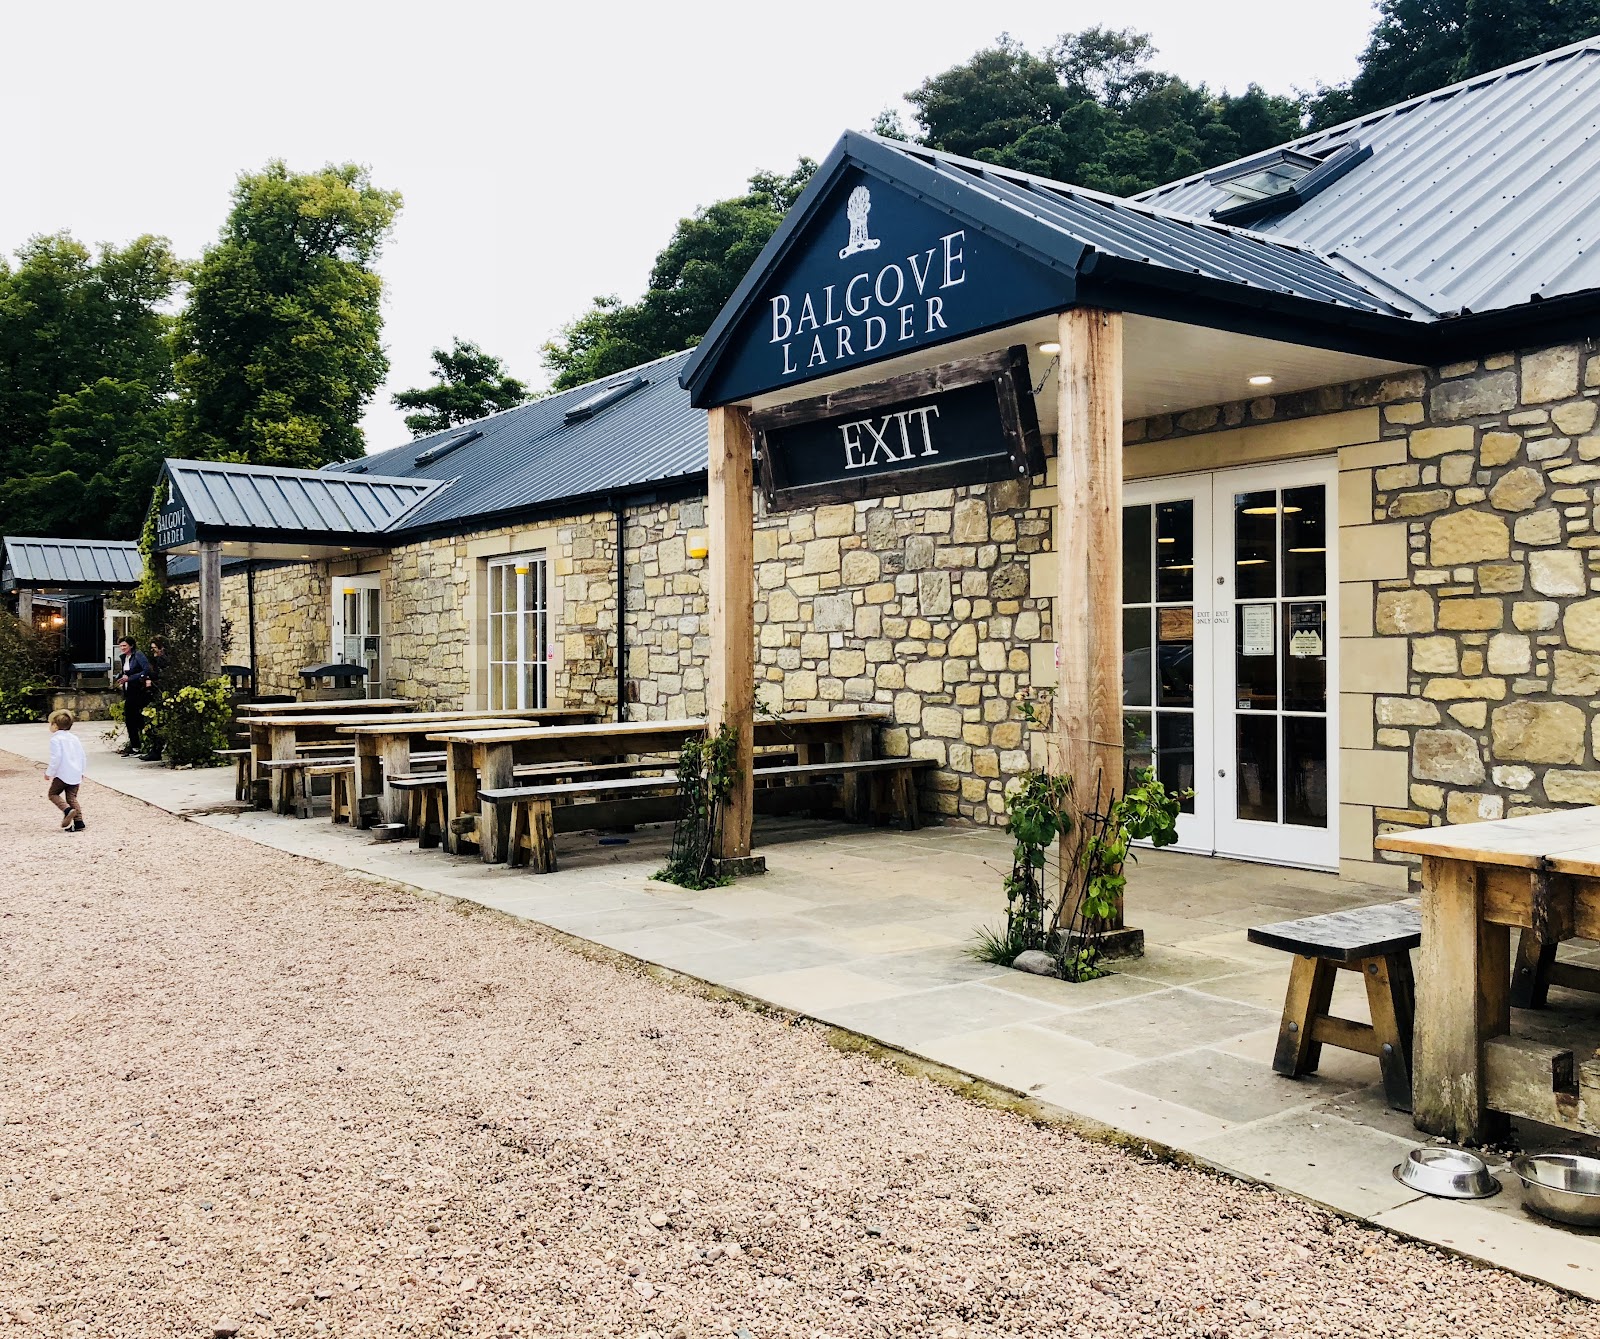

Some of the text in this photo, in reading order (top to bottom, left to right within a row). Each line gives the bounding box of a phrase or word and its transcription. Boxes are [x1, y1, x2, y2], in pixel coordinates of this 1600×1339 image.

[769, 230, 966, 344] BALGOVE
[782, 296, 948, 375] LARDER
[838, 405, 940, 470] EXIT
[157, 507, 186, 532] BALGOVE
[159, 528, 184, 546] LARDER
